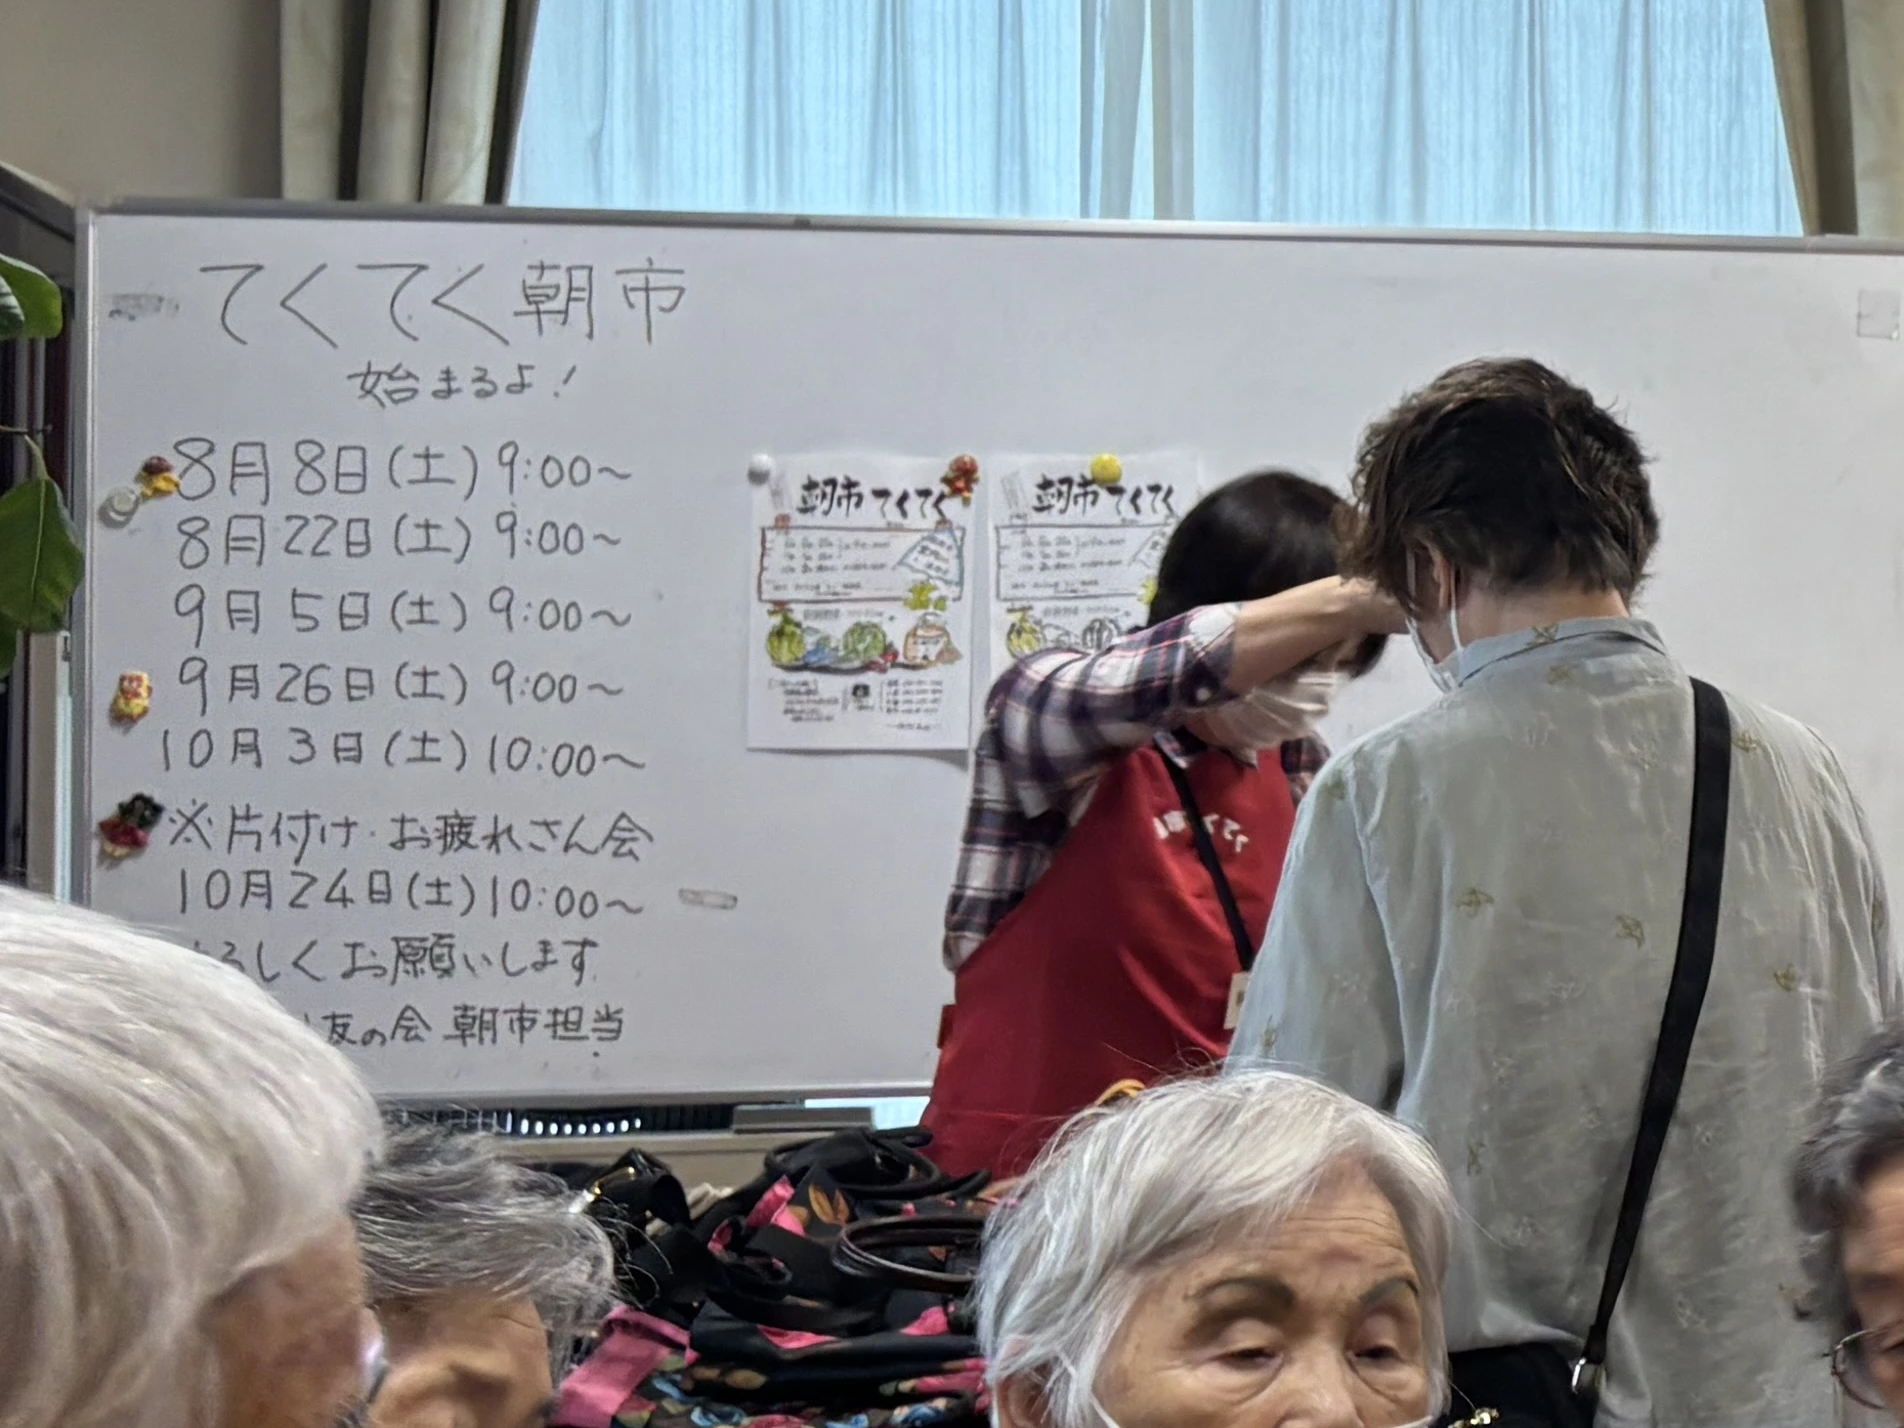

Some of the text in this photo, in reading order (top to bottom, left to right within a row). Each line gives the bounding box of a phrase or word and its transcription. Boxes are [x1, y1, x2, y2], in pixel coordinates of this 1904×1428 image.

[199, 257, 686, 348] てくてく朝市
[194, 934, 599, 985] ろしくお願いします
